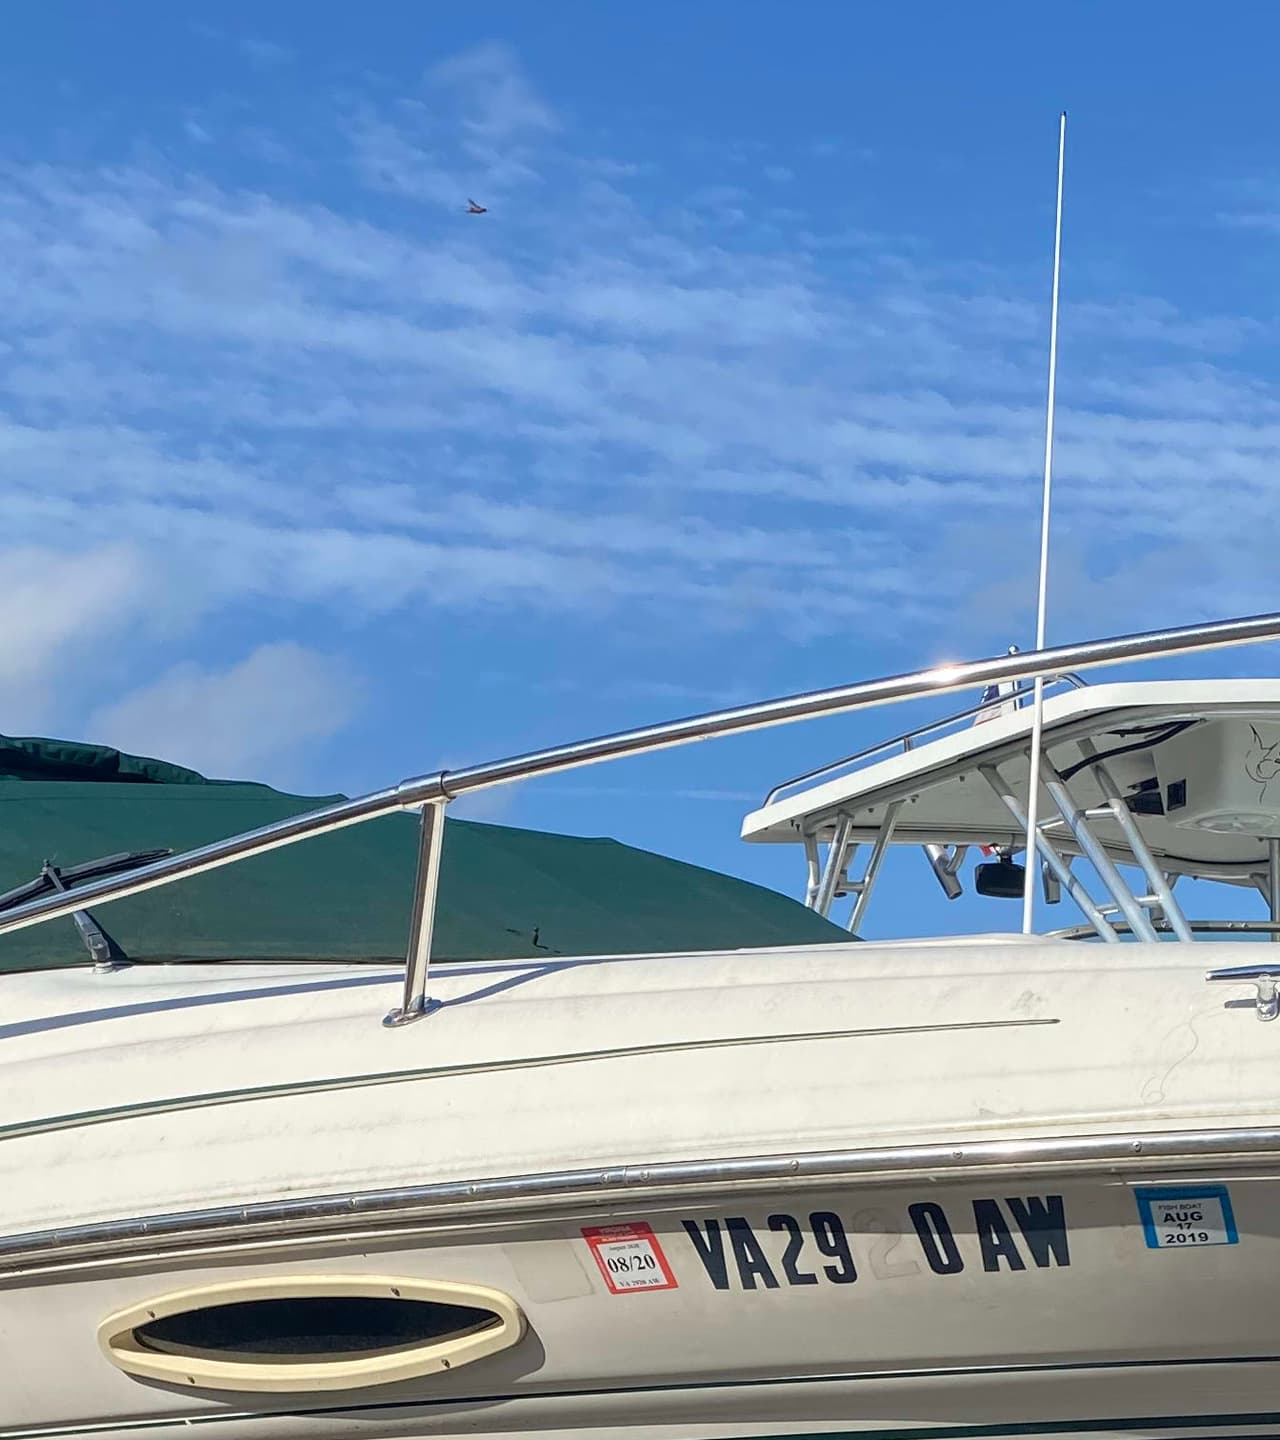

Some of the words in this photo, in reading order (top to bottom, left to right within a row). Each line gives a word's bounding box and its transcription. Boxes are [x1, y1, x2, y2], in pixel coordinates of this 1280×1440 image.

[1163, 1211, 1203, 1223] AUG
[1176, 1222, 1193, 1230] 17
[680, 1211, 858, 1290] VA29
[972, 1195, 1070, 1272] AW
[1165, 1232, 1209, 1244] 2019
[607, 1254, 656, 1273] 08/20
